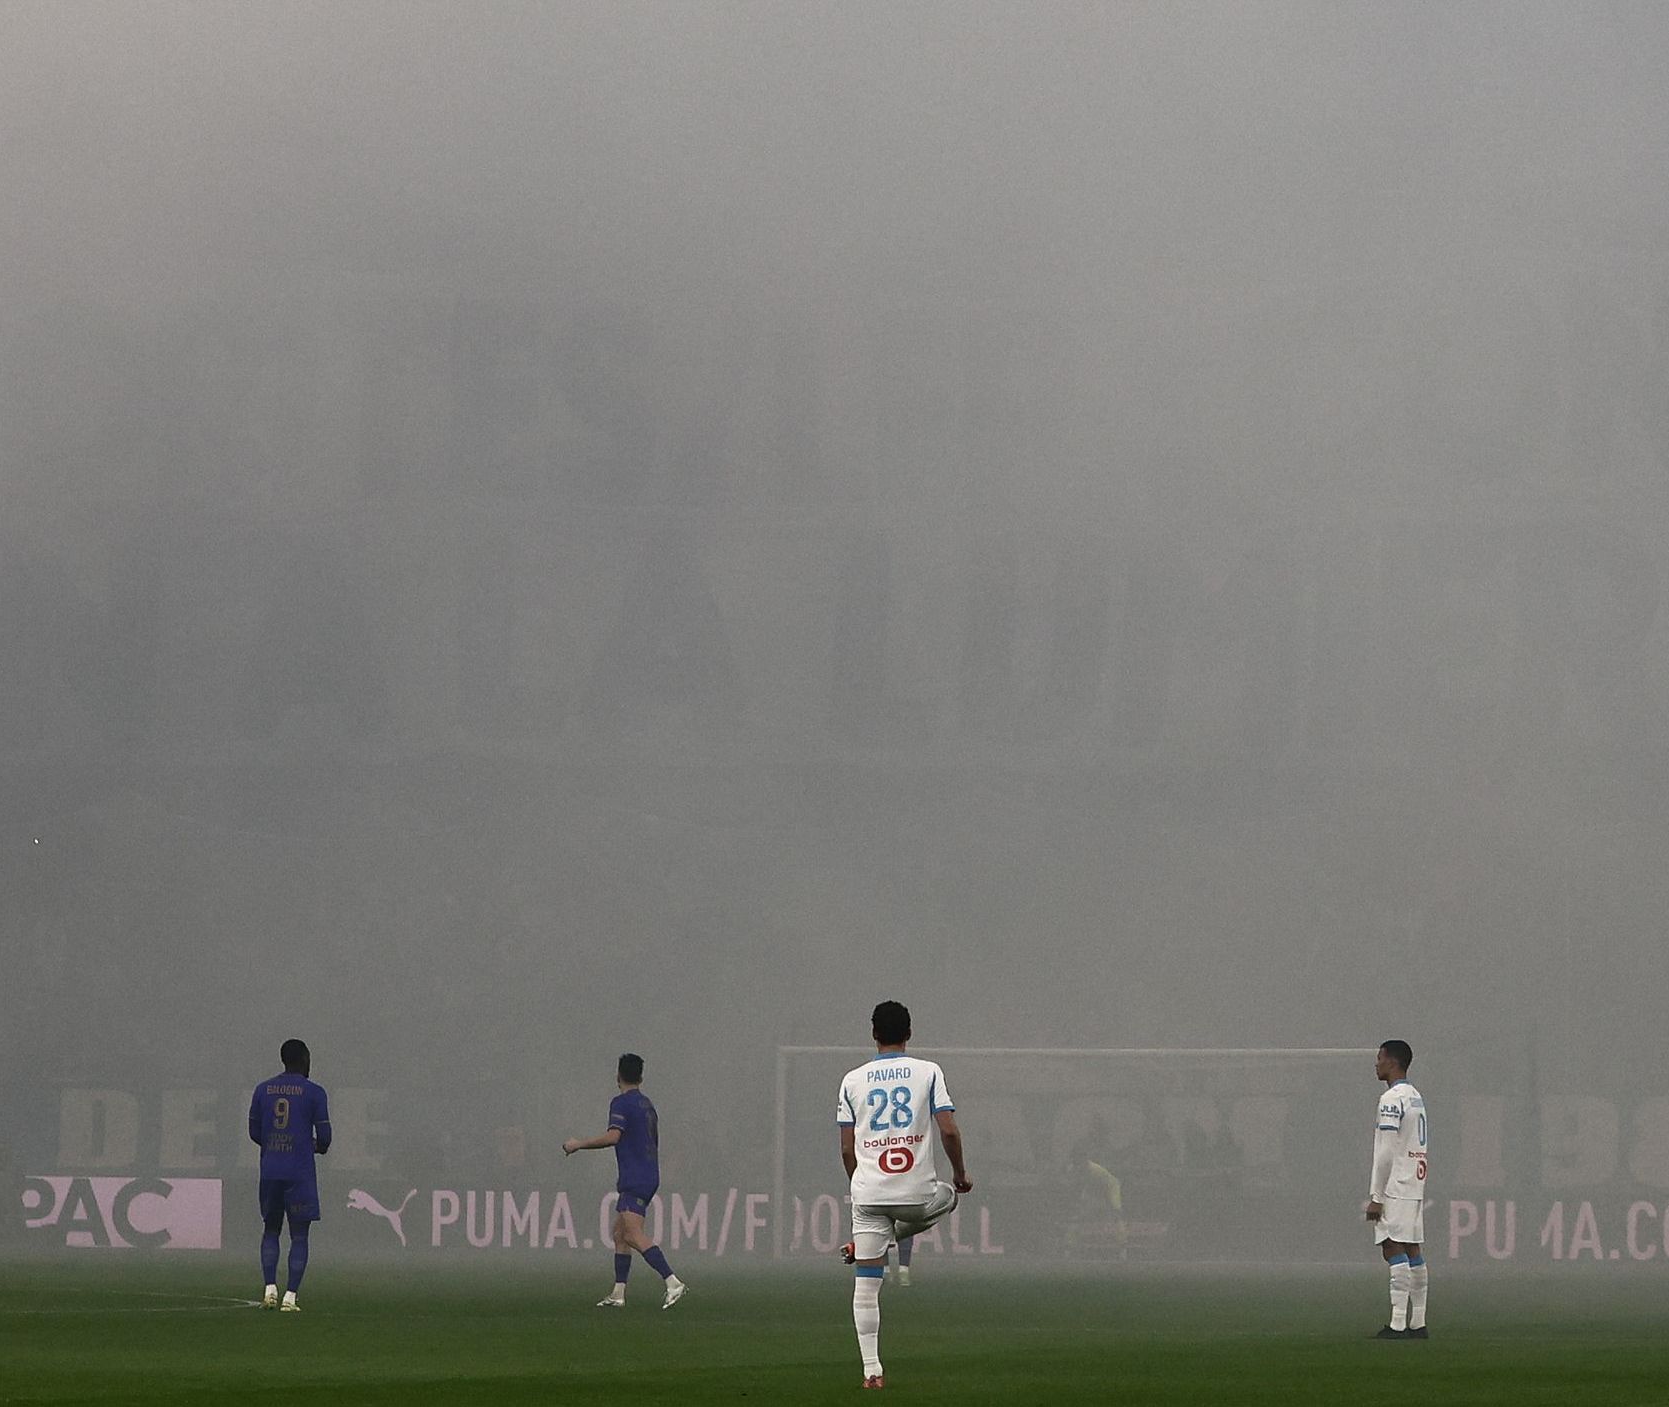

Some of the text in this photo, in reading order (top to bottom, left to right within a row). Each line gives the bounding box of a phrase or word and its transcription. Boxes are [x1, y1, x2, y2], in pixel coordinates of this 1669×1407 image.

[867, 1067, 911, 1083] PAVARD
[274, 1097, 290, 1130] 9
[867, 1086, 914, 1132] 28
[864, 1134, 925, 1149] boulanger
[434, 1188, 1005, 1256] PUMA.CM/FOLL
